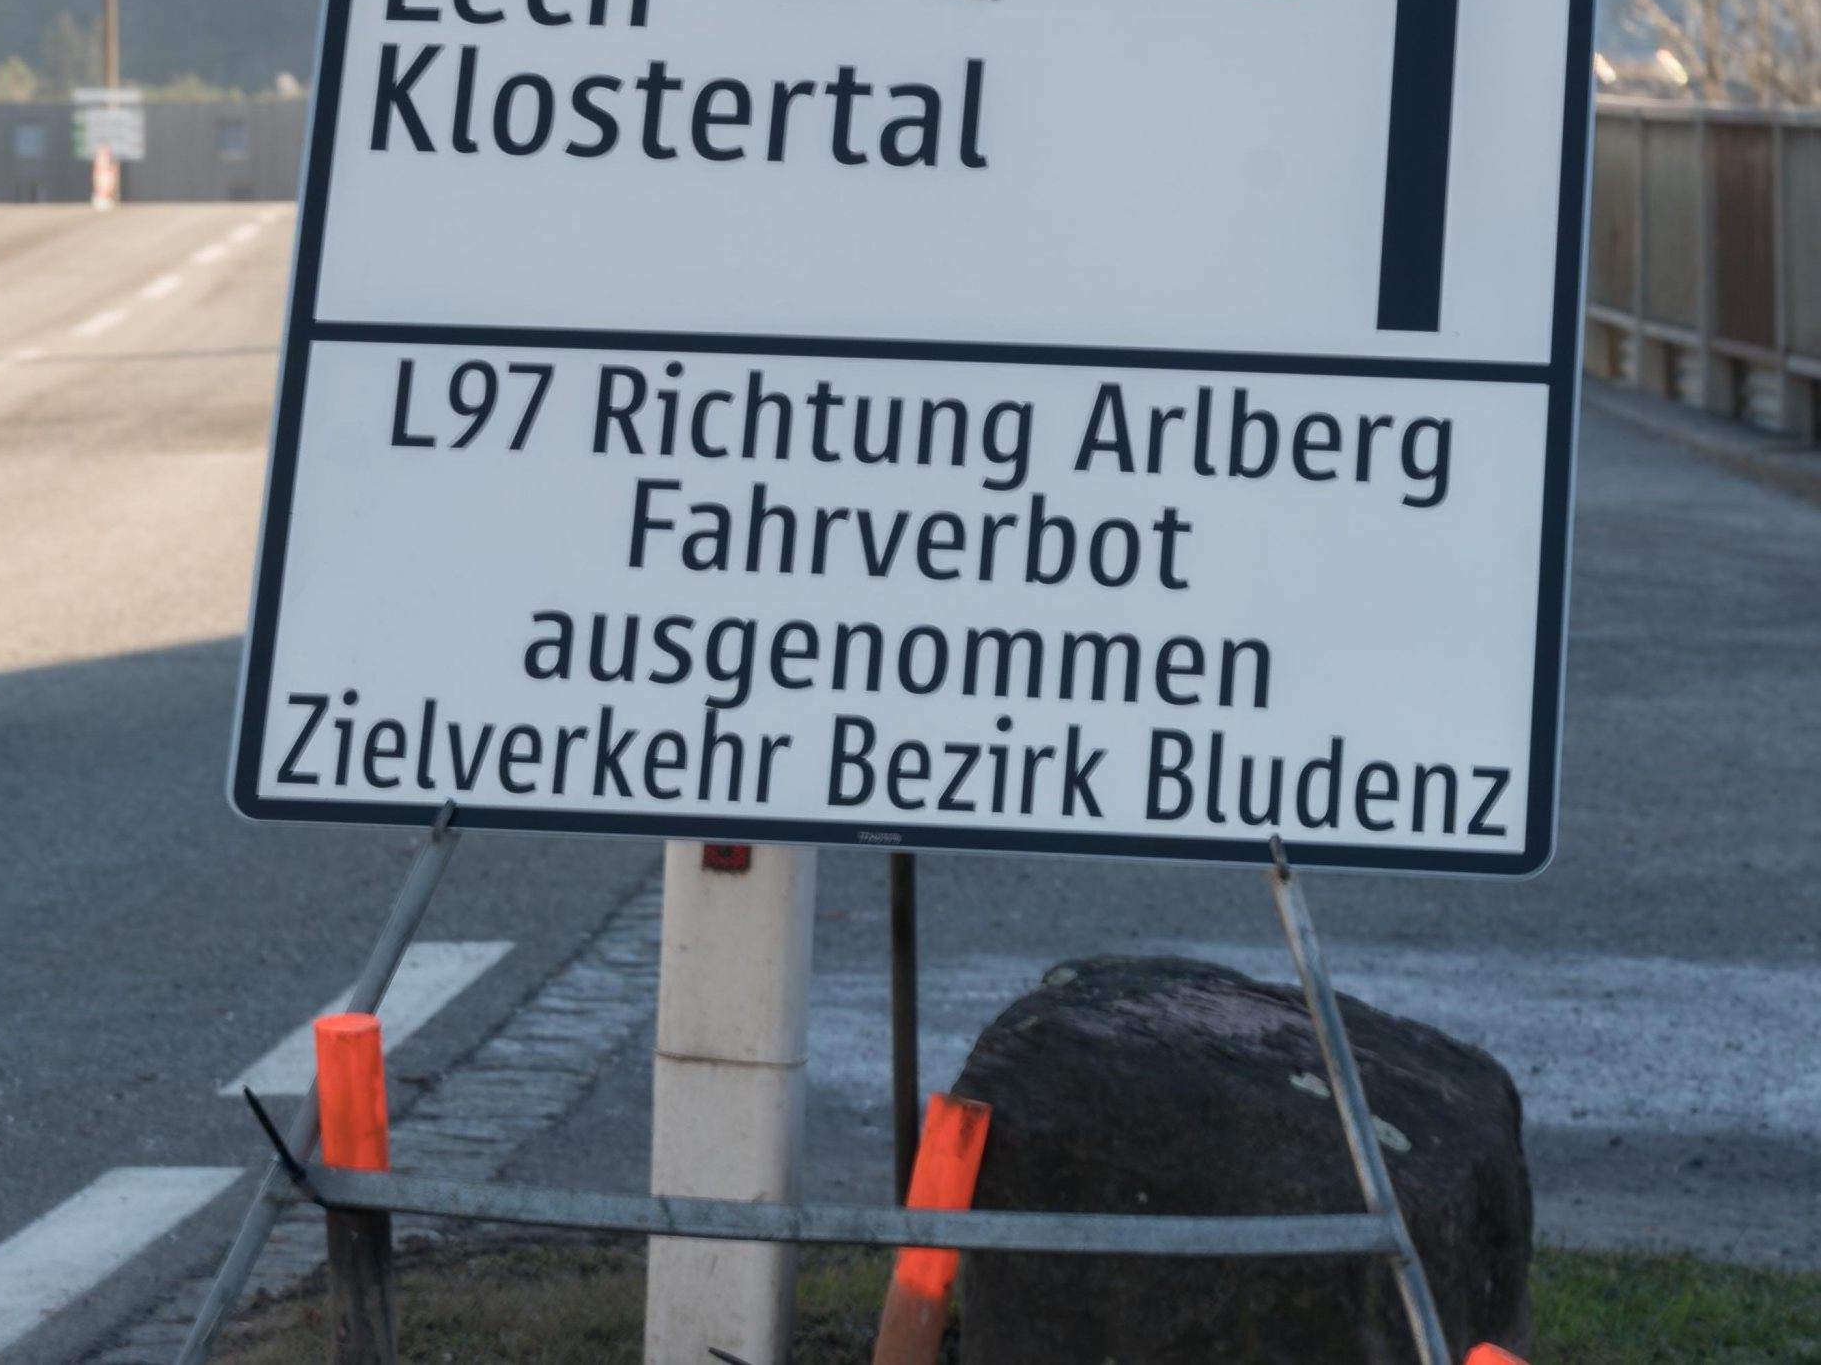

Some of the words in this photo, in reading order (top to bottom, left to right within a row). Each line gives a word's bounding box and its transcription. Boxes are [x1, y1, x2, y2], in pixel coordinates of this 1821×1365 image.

[369, 42, 988, 170] Klostertal
[390, 358, 555, 452] L97
[591, 361, 1034, 493] Richtung
[1073, 382, 1453, 510] Arlberg
[627, 477, 1193, 591] Fahrverbot
[523, 609, 1272, 712] ausgenommen
[275, 688, 793, 804] Zielverkehr
[826, 714, 1105, 819] Bezirk
[1144, 727, 1512, 838] Bludenz
